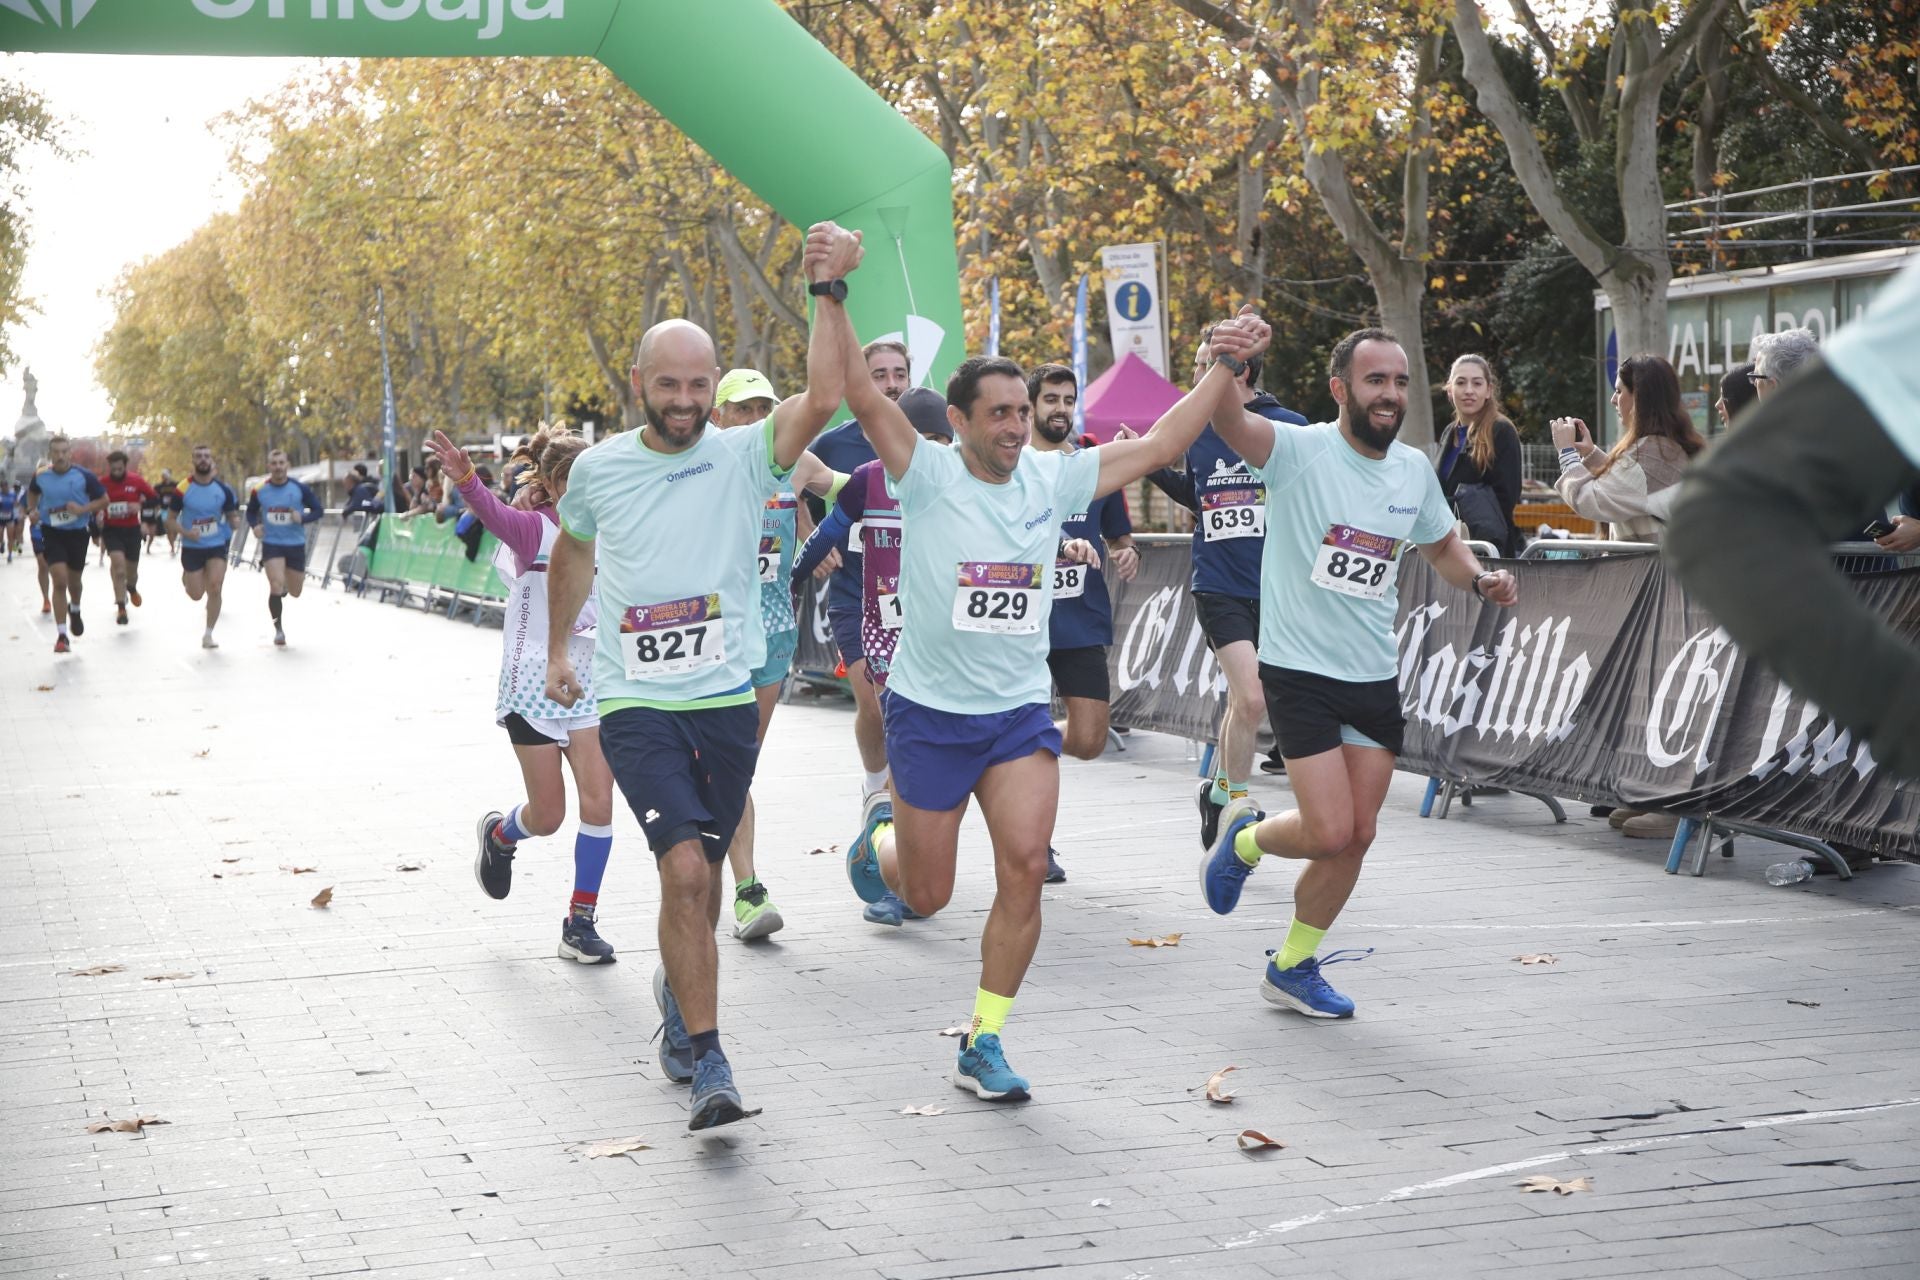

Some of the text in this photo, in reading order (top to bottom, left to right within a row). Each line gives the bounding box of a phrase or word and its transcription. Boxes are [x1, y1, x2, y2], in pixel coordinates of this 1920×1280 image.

[666, 461, 714, 482] OneHealth
[1211, 508, 1255, 531] 639
[1388, 505, 1418, 515] OneHealth
[1353, 537, 1386, 551] EMPRESAS
[987, 571, 1019, 580] EMPRESAS
[1327, 551, 1387, 587] 828
[649, 601, 688, 615] CARRERA DE
[650, 609, 689, 622] EMPRESAS
[967, 590, 1028, 621] 829
[511, 585, 531, 694] www.castilviejo.es
[636, 626, 707, 663] 827
[1397, 600, 1593, 746] Castilla
